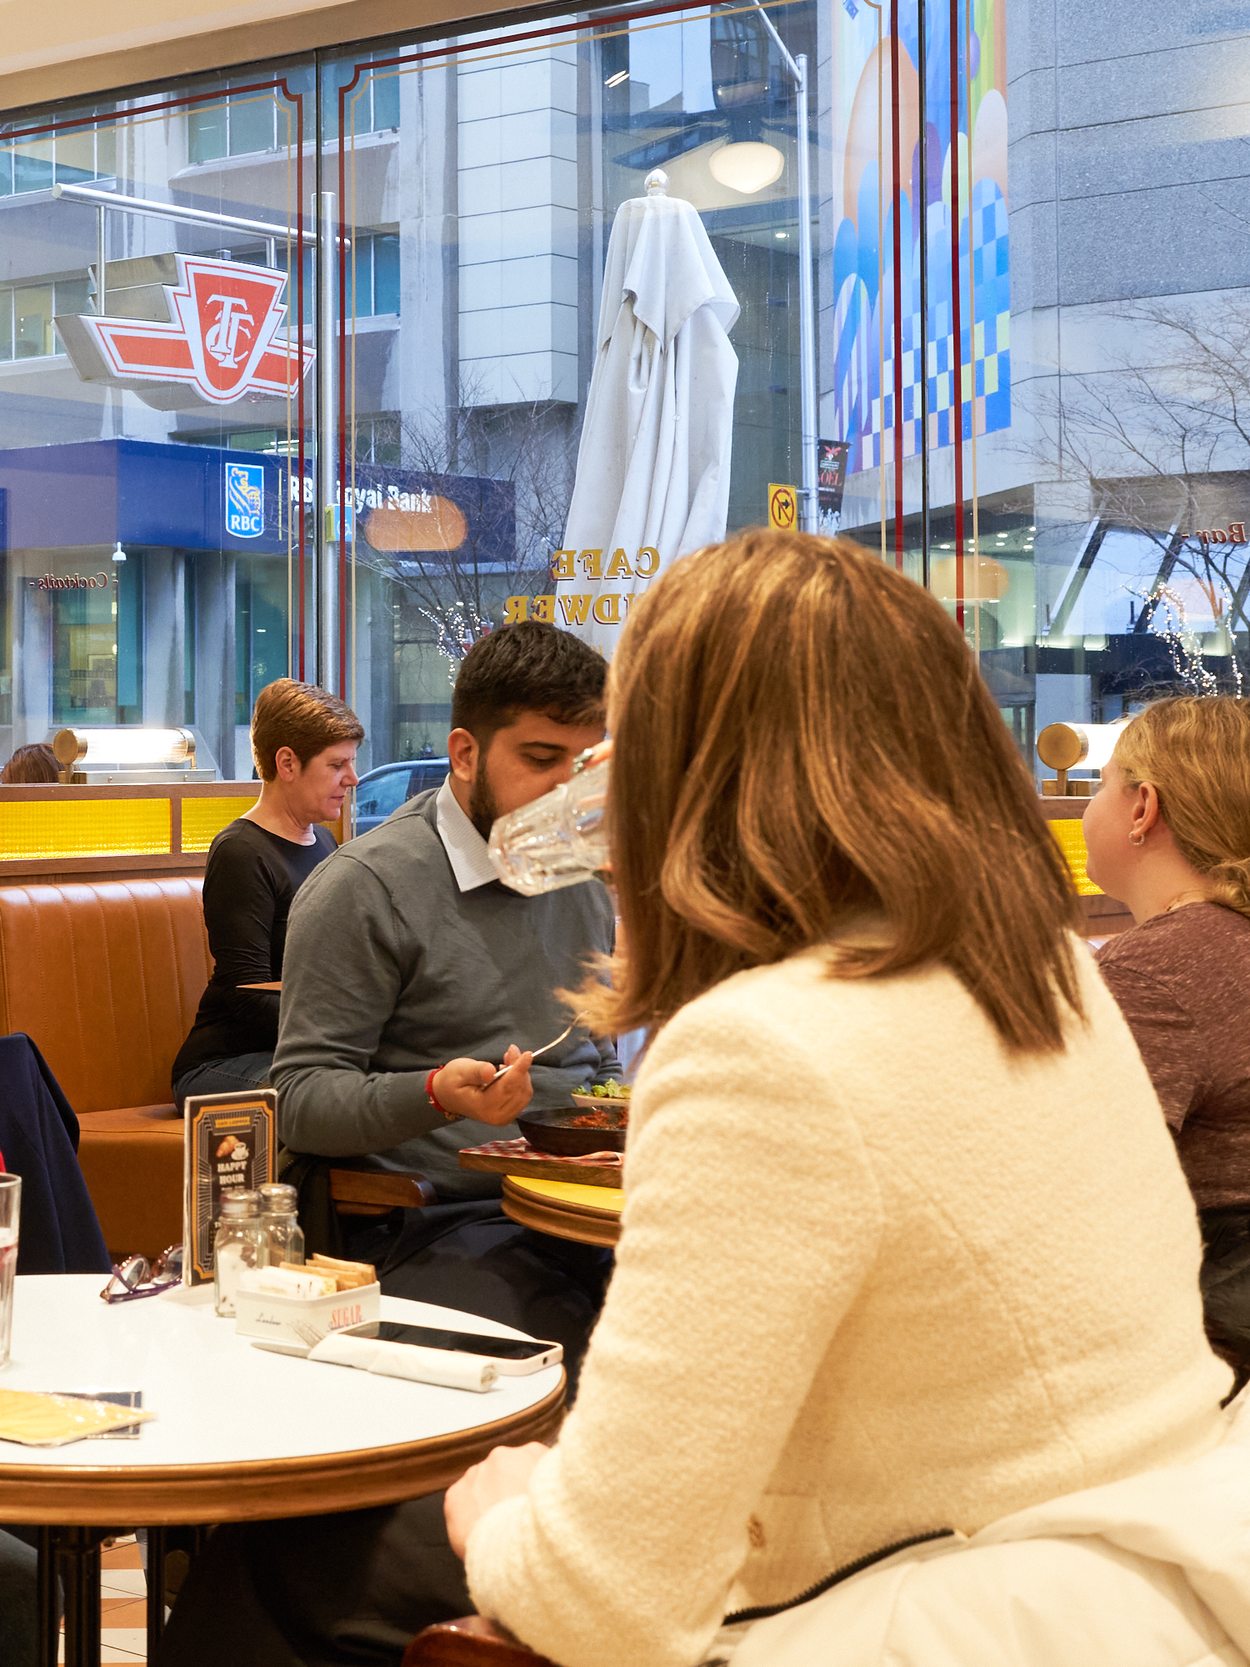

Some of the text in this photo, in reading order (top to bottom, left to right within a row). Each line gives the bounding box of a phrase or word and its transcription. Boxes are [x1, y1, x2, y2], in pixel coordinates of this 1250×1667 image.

[291, 475, 314, 503] RB
[387, 485, 433, 513] Bank
[230, 514, 261, 532] RBC
[217, 1161, 248, 1174] HAPPY
[219, 1173, 246, 1186] HOUR
